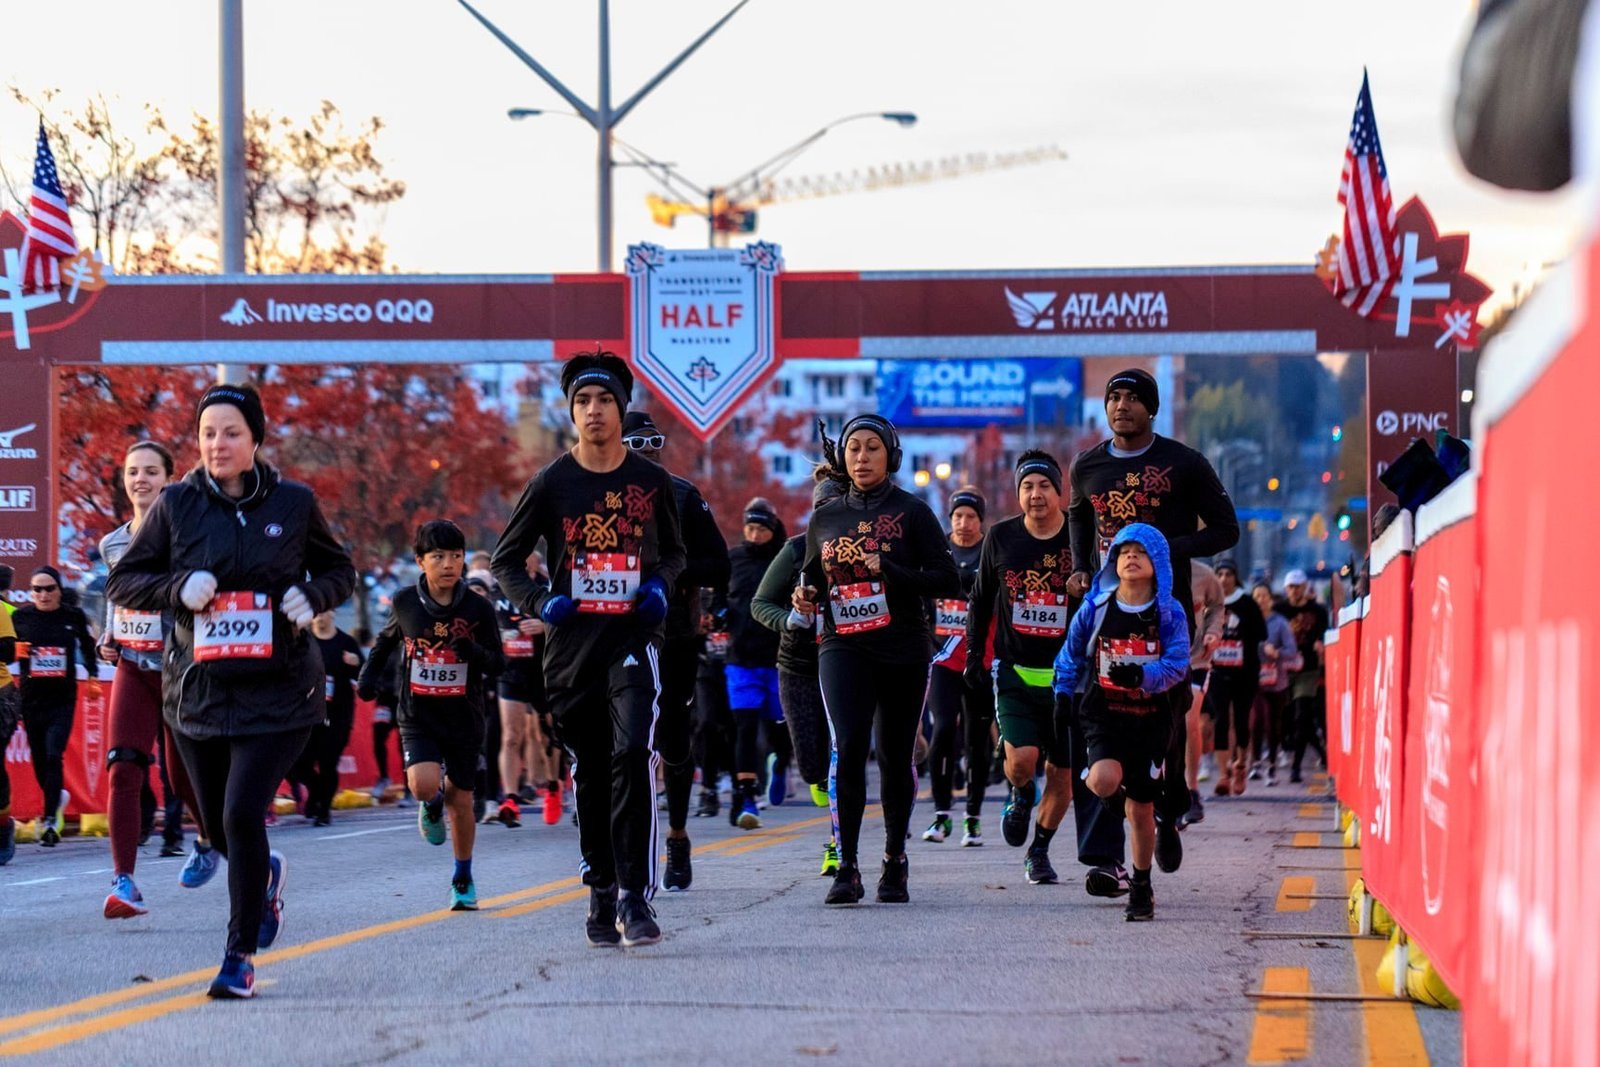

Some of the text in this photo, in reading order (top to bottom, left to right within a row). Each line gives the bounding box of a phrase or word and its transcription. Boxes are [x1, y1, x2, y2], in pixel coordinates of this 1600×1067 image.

[266, 298, 434, 323] Invesco QQQ
[1061, 291, 1168, 317] ATLANTA
[661, 304, 743, 328] HALF
[1062, 316, 1168, 329] TRACK CLUB
[912, 363, 1025, 387] SOUND
[1401, 411, 1448, 432] PNC
[583, 579, 627, 595] 2351
[839, 602, 879, 619] 4060
[1021, 609, 1058, 623] 4184
[121, 621, 152, 635] 3167
[205, 619, 260, 638] 2399
[941, 614, 967, 626] 2046
[419, 668, 457, 682] 4185
